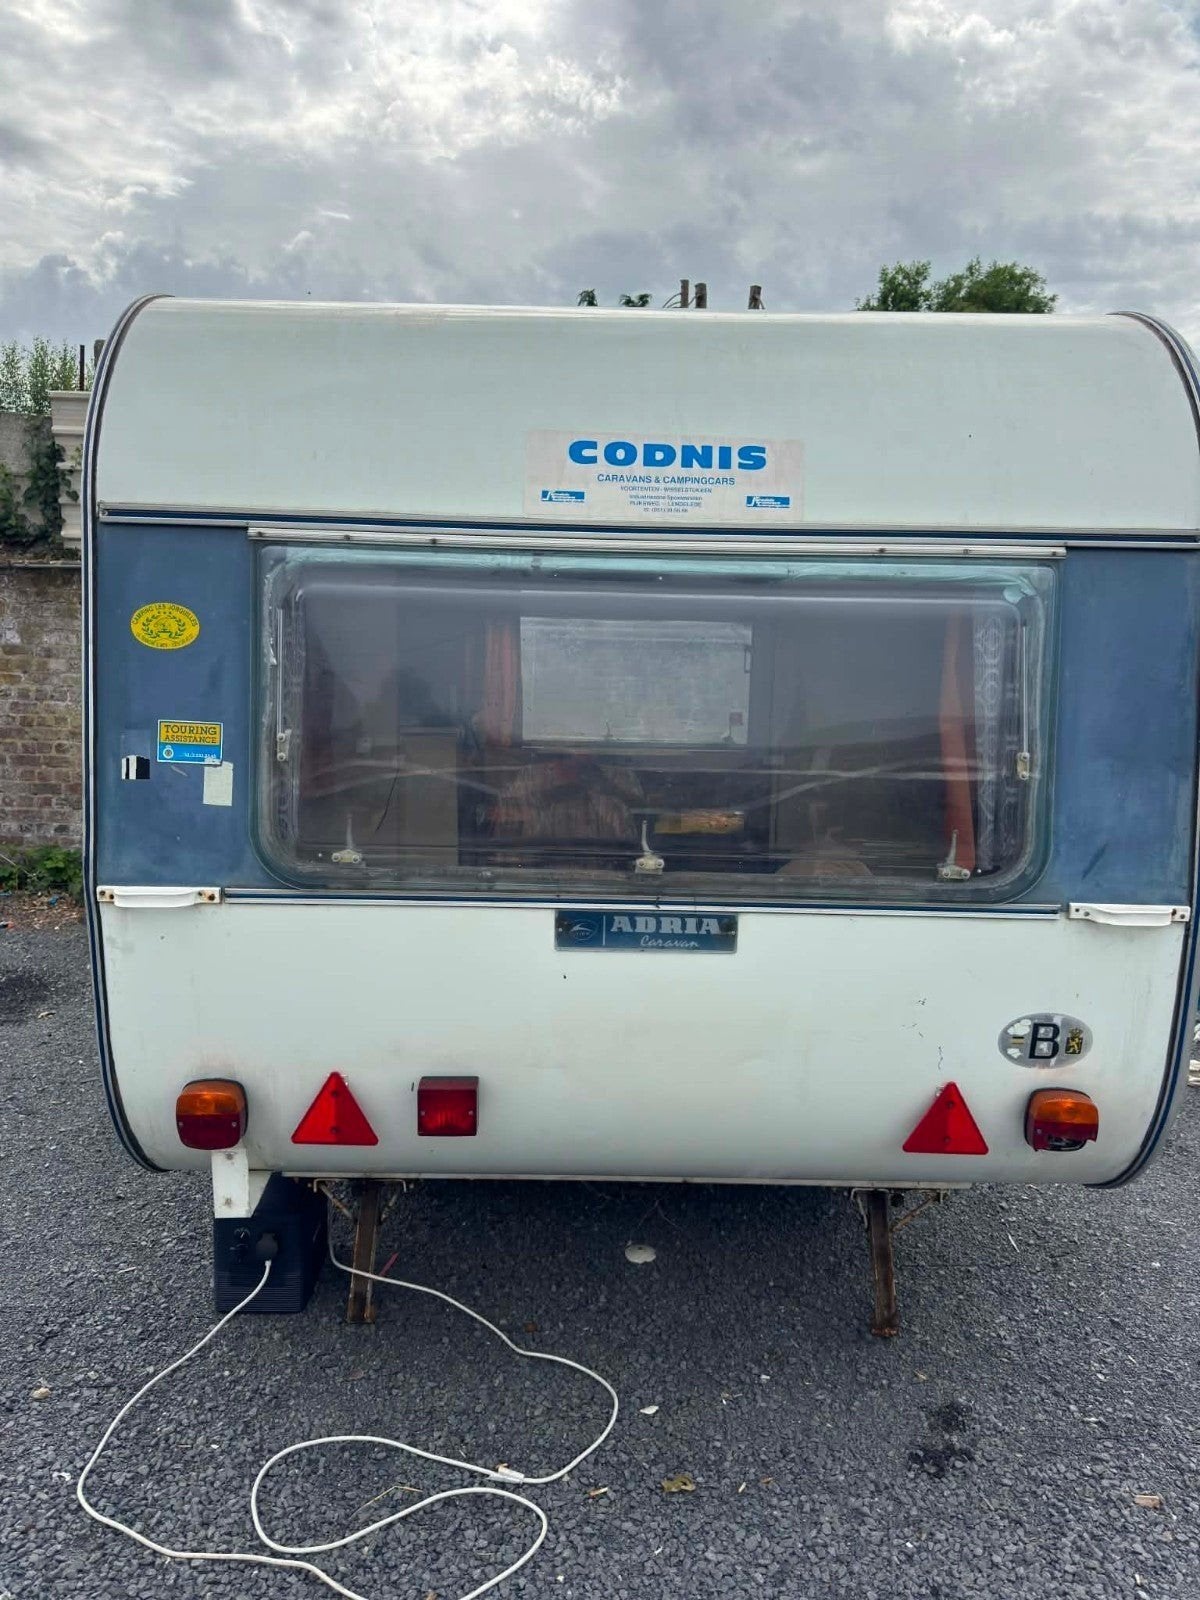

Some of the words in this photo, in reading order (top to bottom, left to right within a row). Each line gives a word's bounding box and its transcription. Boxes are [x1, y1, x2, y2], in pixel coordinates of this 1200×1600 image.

[568, 440, 767, 470] CODNIS
[597, 473, 652, 484] CARAVANS
[654, 476, 662, 484] &
[663, 476, 736, 486] CAMPINGCARS
[164, 724, 217, 736] TOURING
[164, 735, 217, 744] ASSISTANCE
[610, 915, 721, 935] ADRIA
[640, 935, 699, 948] Caravan
[1028, 1022, 1060, 1059] B
